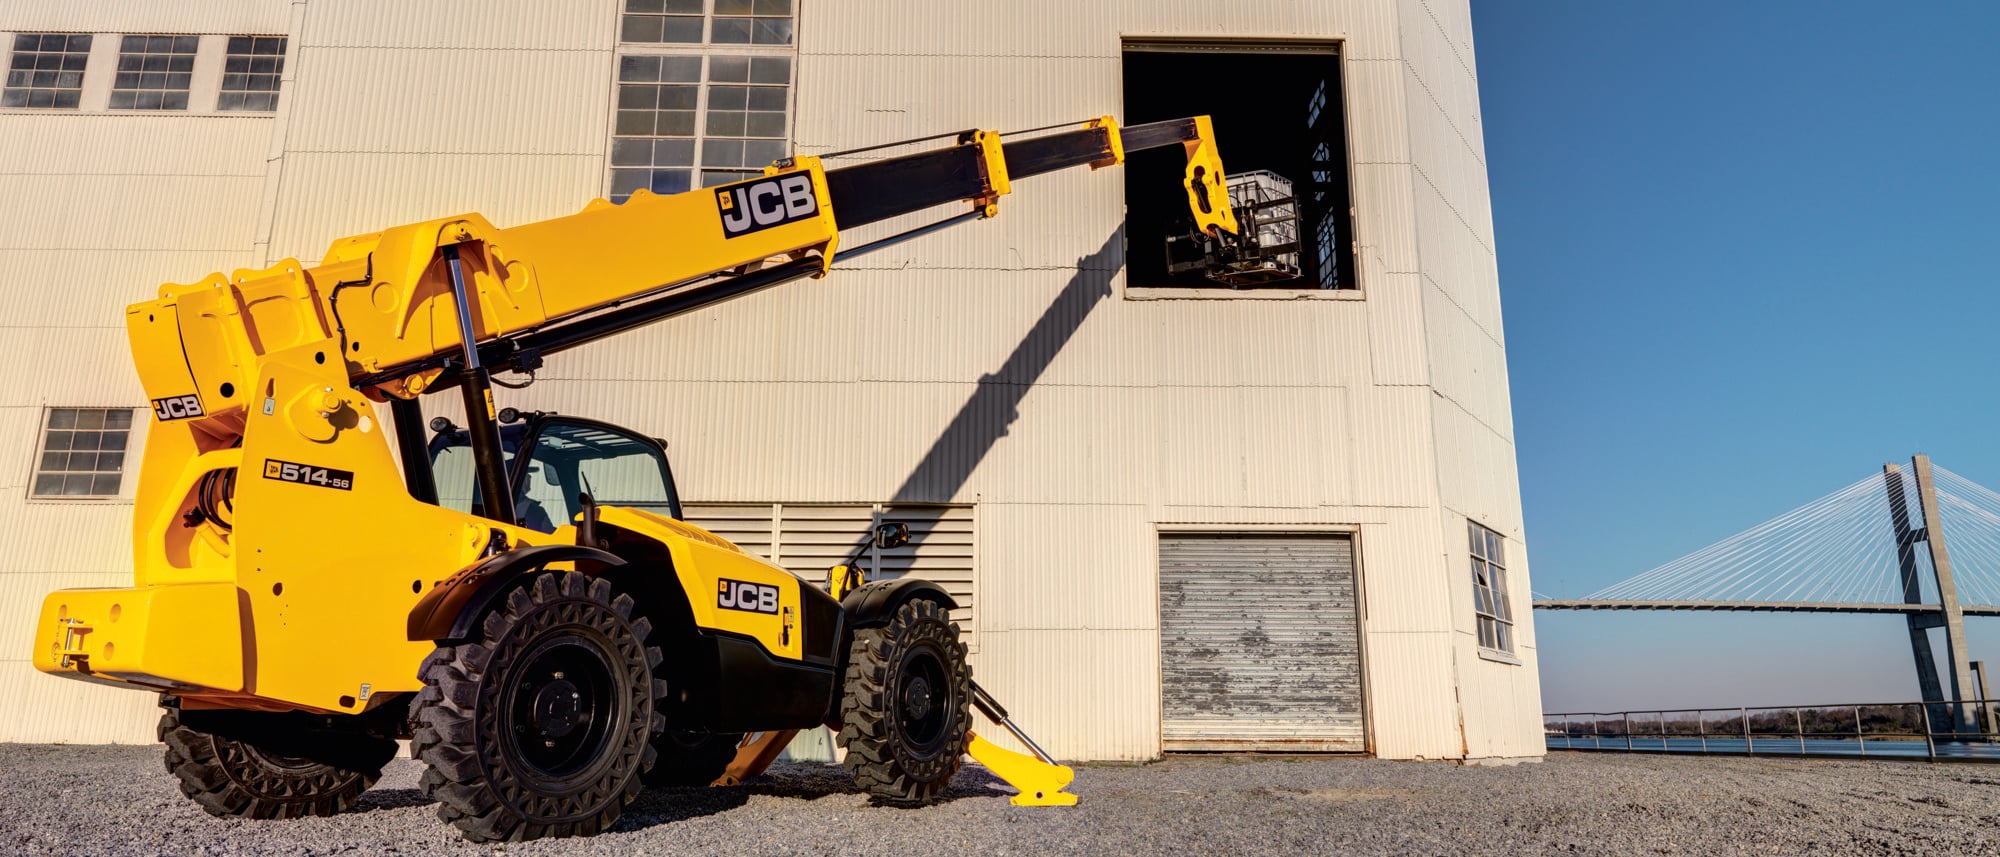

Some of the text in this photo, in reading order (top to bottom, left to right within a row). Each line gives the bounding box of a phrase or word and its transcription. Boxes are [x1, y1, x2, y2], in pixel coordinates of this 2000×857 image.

[723, 175, 816, 233] JCB
[156, 395, 202, 420] JCB
[719, 582, 778, 612] JCB
